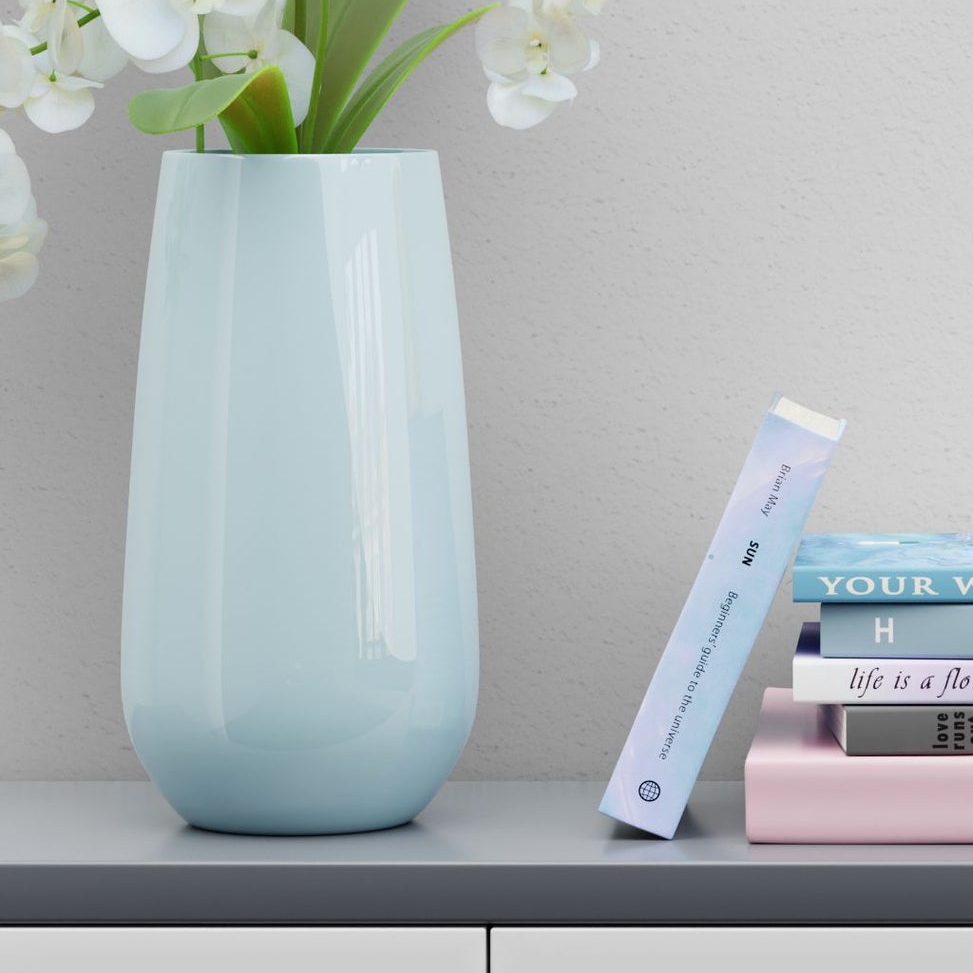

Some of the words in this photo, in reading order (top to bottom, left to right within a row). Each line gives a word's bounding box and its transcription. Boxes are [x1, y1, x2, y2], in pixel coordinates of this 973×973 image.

[772, 464, 791, 492] Brian
[760, 494, 779, 517] May
[742, 540, 759, 566] SUN
[819, 577, 939, 596] YOUR
[693, 647, 712, 678] guide
[687, 678, 699, 692] to
[849, 668, 883, 698] life
[894, 671, 911, 690] is
[920, 676, 935, 690] a
[678, 694, 693, 713] the
[658, 714, 684, 761] universe
[932, 713, 949, 749] love
[954, 712, 965, 750] runs
